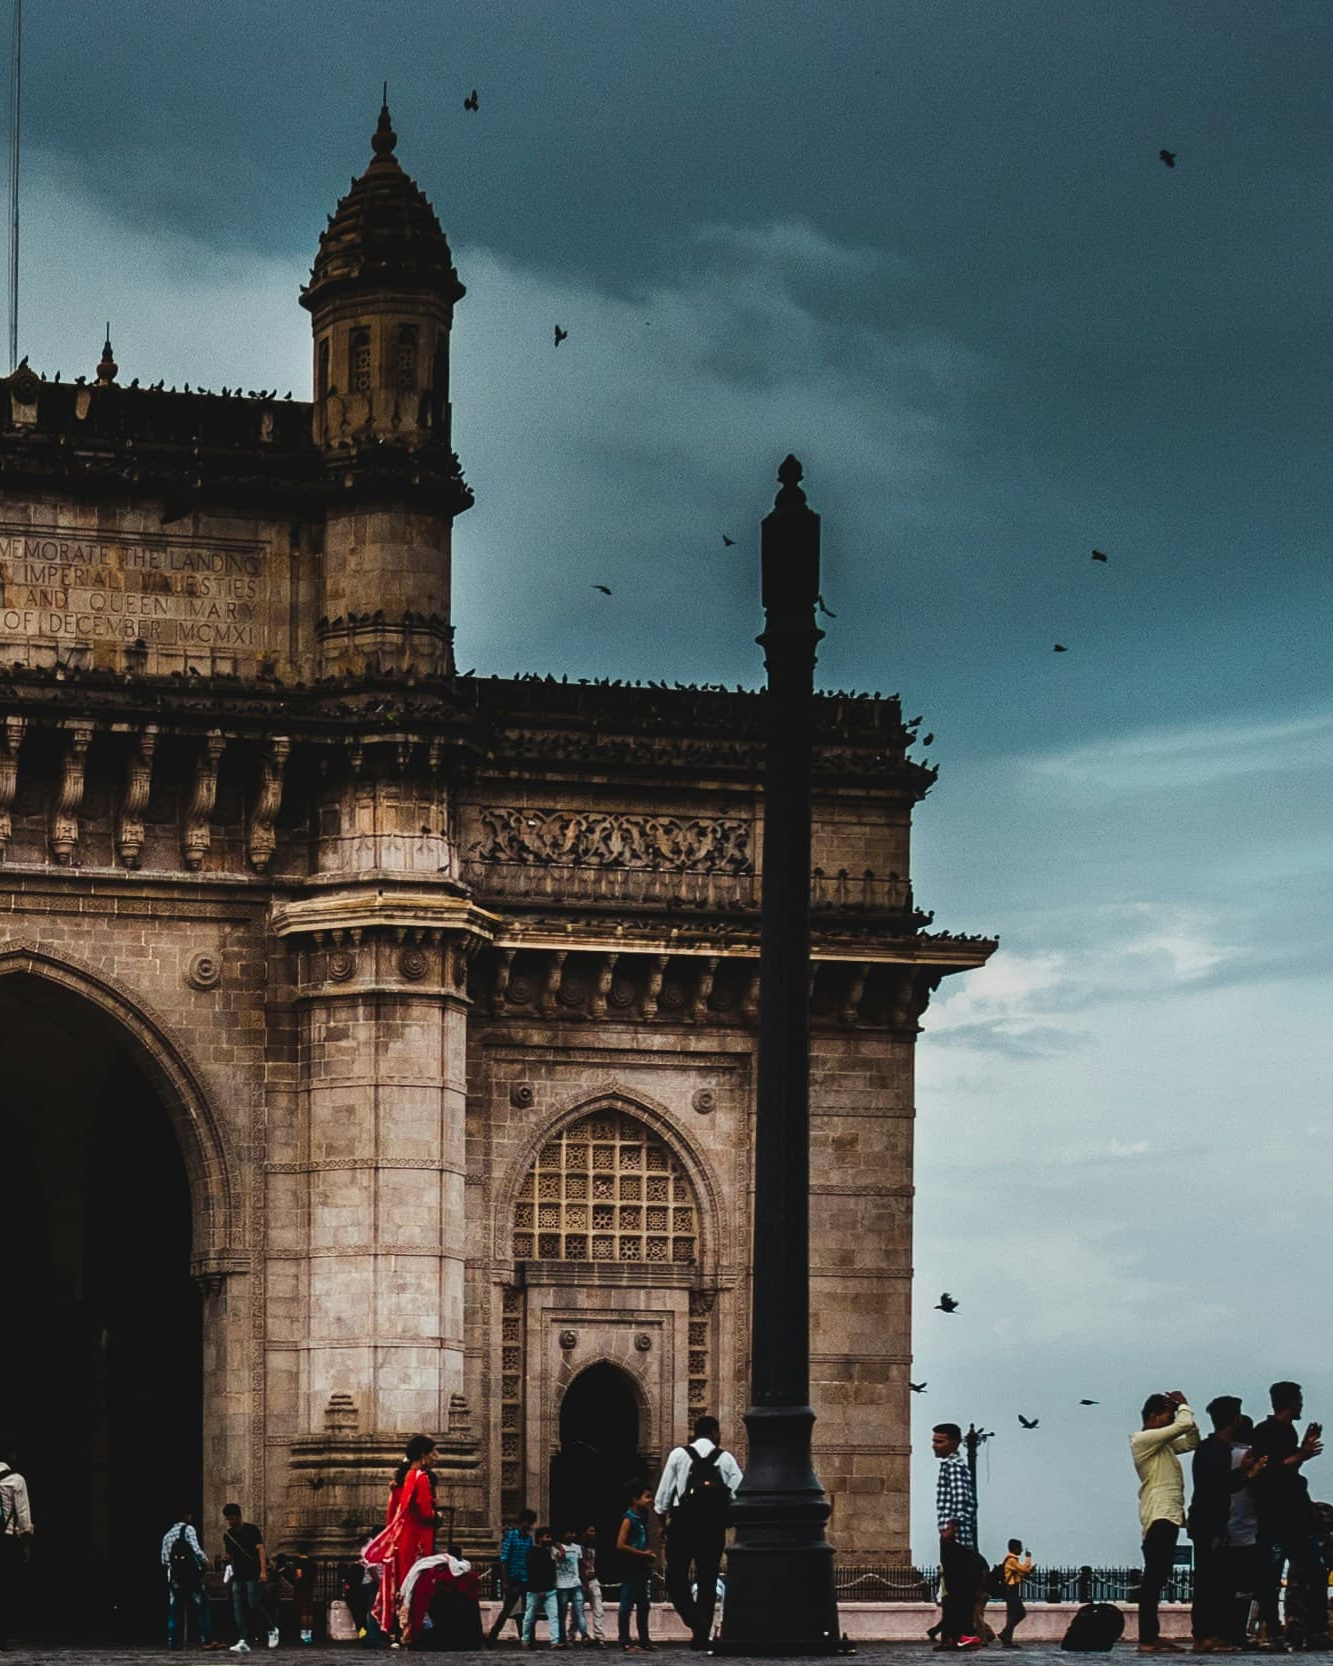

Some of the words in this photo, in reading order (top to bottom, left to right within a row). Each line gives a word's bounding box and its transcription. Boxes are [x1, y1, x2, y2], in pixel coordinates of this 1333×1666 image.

[124, 547, 161, 569] THE
[170, 552, 259, 576] LANDING
[25, 564, 120, 590] IMPERIAL
[142, 571, 256, 599] MAJESTIES
[25, 589, 68, 609] AND
[89, 593, 168, 615] QUEEN
[189, 600, 257, 620] MARY
[4, 611, 34, 630] OF
[50, 613, 161, 639] DECEMBER
[178, 622, 253, 645] MCMXI
